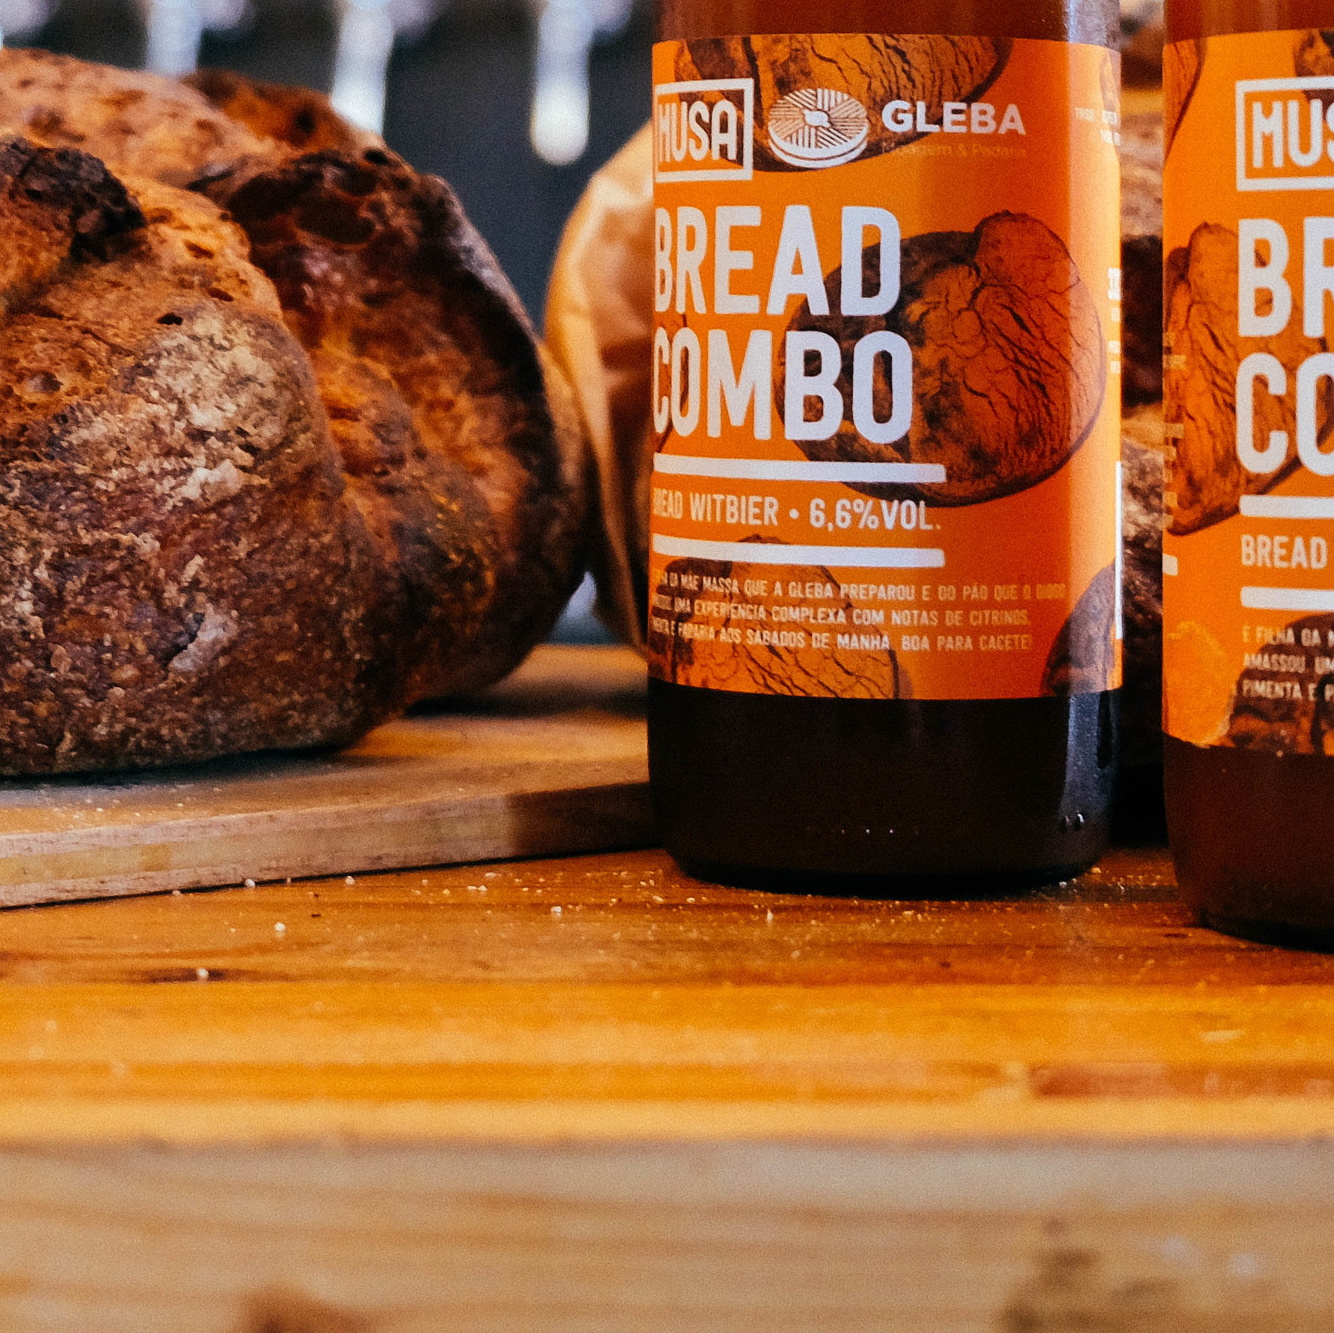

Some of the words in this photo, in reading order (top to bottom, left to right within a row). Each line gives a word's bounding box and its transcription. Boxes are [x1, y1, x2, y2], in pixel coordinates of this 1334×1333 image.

[658, 99, 738, 163] MUSA
[881, 99, 1026, 136] GLEBA
[654, 204, 902, 317] BREAD
[653, 326, 914, 444] COMBO
[689, 492, 779, 527] WITBIER
[1240, 534, 1328, 569] BREAD
[703, 575, 740, 595] MASSA
[744, 578, 768, 598] QUE
[773, 581, 783, 597] A
[788, 581, 834, 599] GLEBA
[840, 583, 915, 601] PREPAROU
[921, 584, 932, 601] E
[994, 584, 1018, 602] QUE
[771, 605, 846, 625] COMPLEXA
[852, 608, 885, 626] COM
[891, 609, 939, 626] NOTAS
[945, 610, 963, 626] DE
[719, 626, 742, 644] AOS
[811, 632, 831, 649] DE
[901, 635, 930, 651] BOA
[936, 634, 973, 651] PARA
[1242, 678, 1303, 700] PIMENTA
[1308, 682, 1318, 701] E
